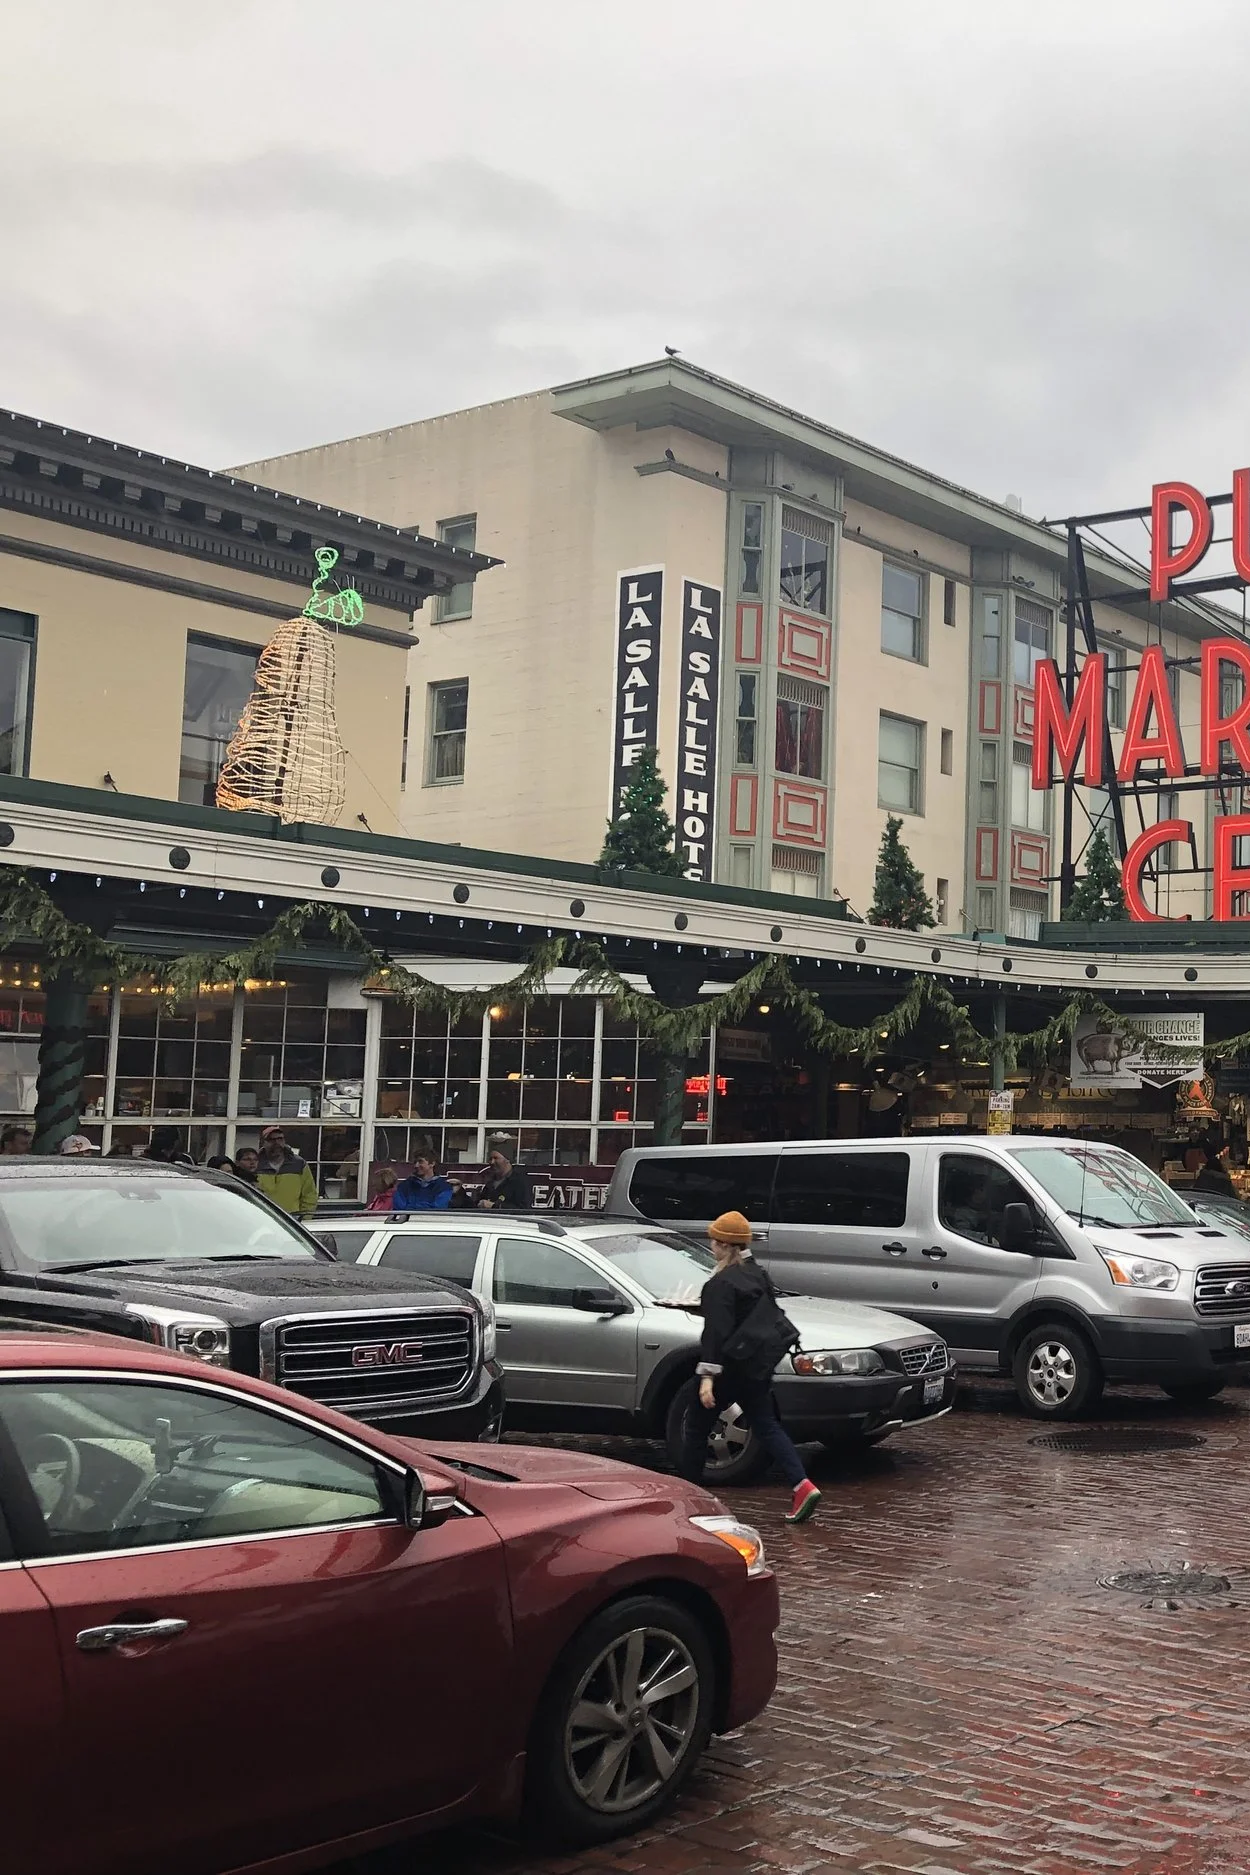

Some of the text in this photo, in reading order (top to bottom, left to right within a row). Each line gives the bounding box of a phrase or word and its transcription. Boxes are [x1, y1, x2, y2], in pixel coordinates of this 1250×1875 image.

[624, 581, 653, 630] LA
[688, 587, 713, 640] LA
[683, 651, 711, 777] SALLE
[1156, 1020, 1200, 1034] CHANGE
[352, 1342, 423, 1366] GMC
